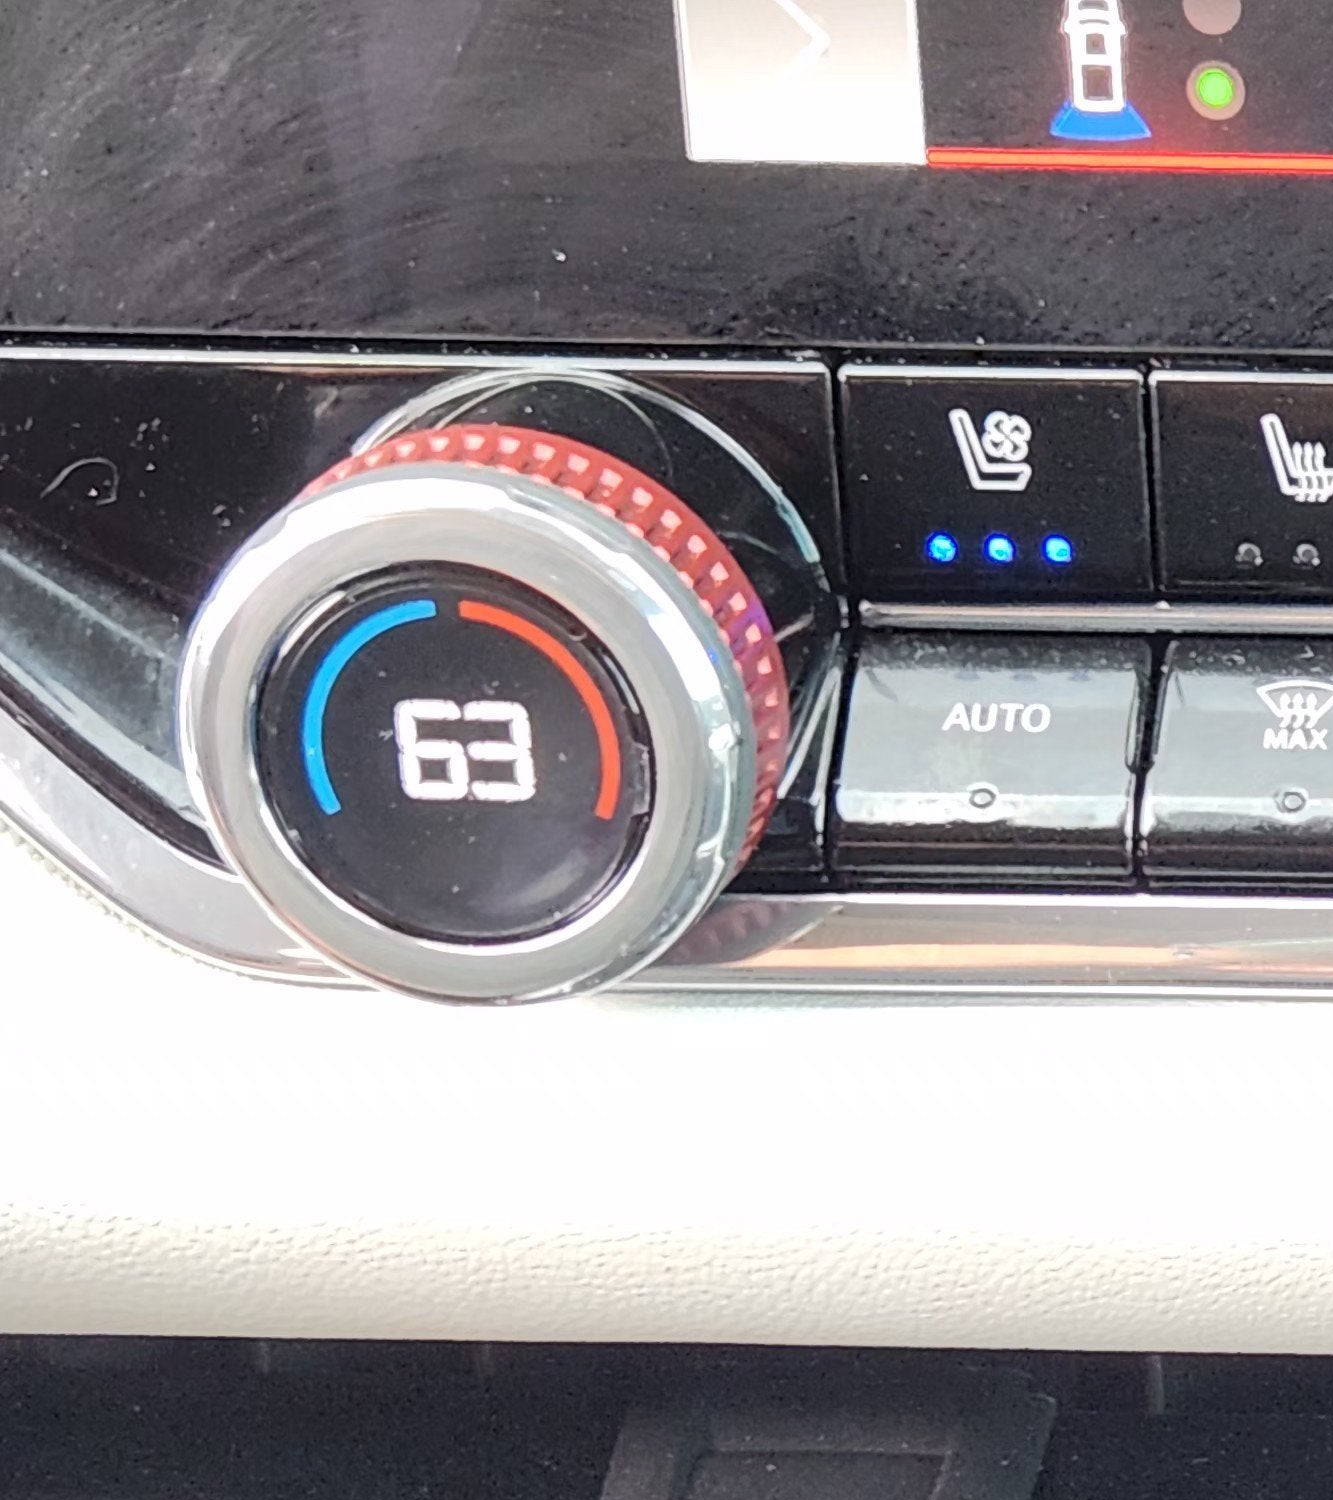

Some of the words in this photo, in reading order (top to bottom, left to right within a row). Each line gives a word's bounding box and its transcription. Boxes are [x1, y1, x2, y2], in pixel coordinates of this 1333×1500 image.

[942, 701, 1052, 733] AUTO
[393, 697, 537, 803] 63
[1262, 727, 1329, 751] MAX
